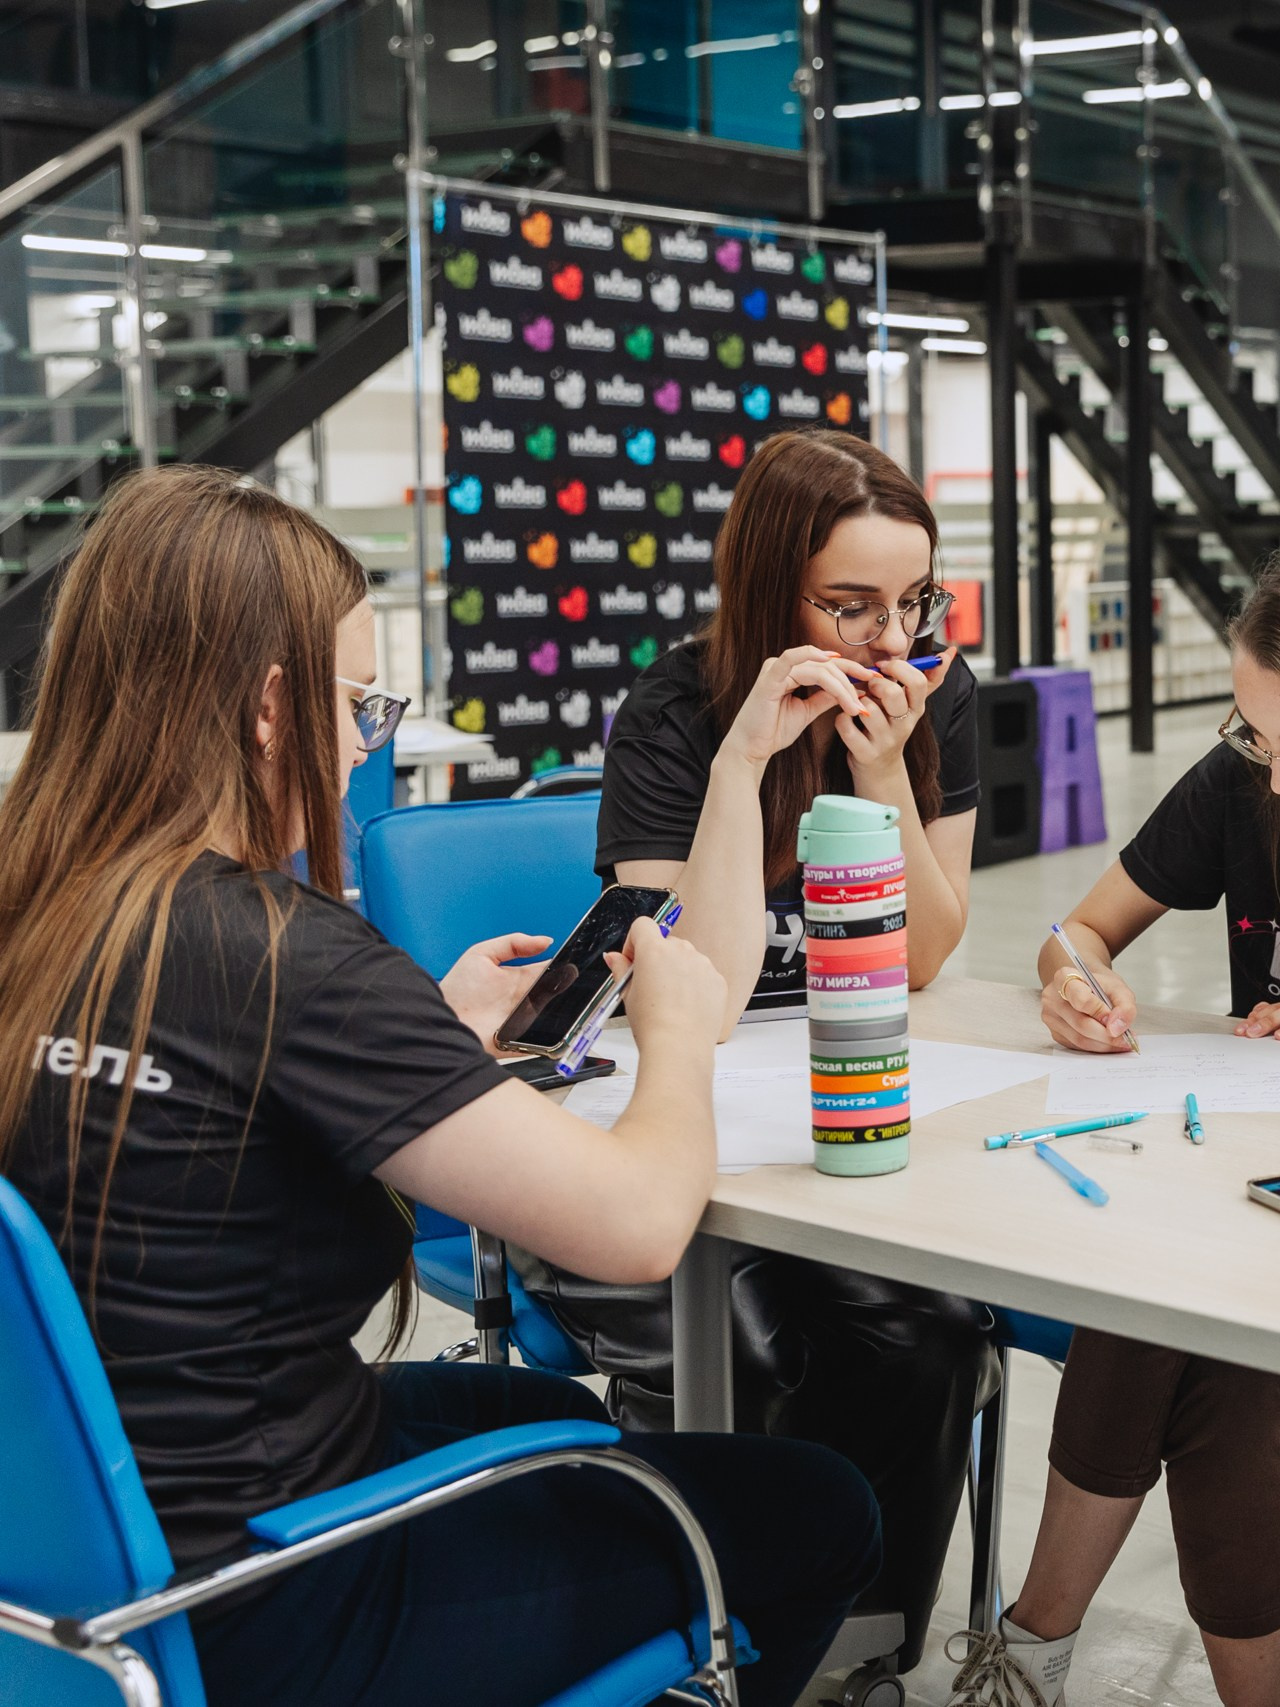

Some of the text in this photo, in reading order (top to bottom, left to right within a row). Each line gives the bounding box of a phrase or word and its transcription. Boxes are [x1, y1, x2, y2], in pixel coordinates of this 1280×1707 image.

[825, 976, 870, 989] МИРЭА
[31, 1034, 173, 1093] тель
[846, 1060, 884, 1072] весна
[887, 1055, 904, 1068] РТУ
